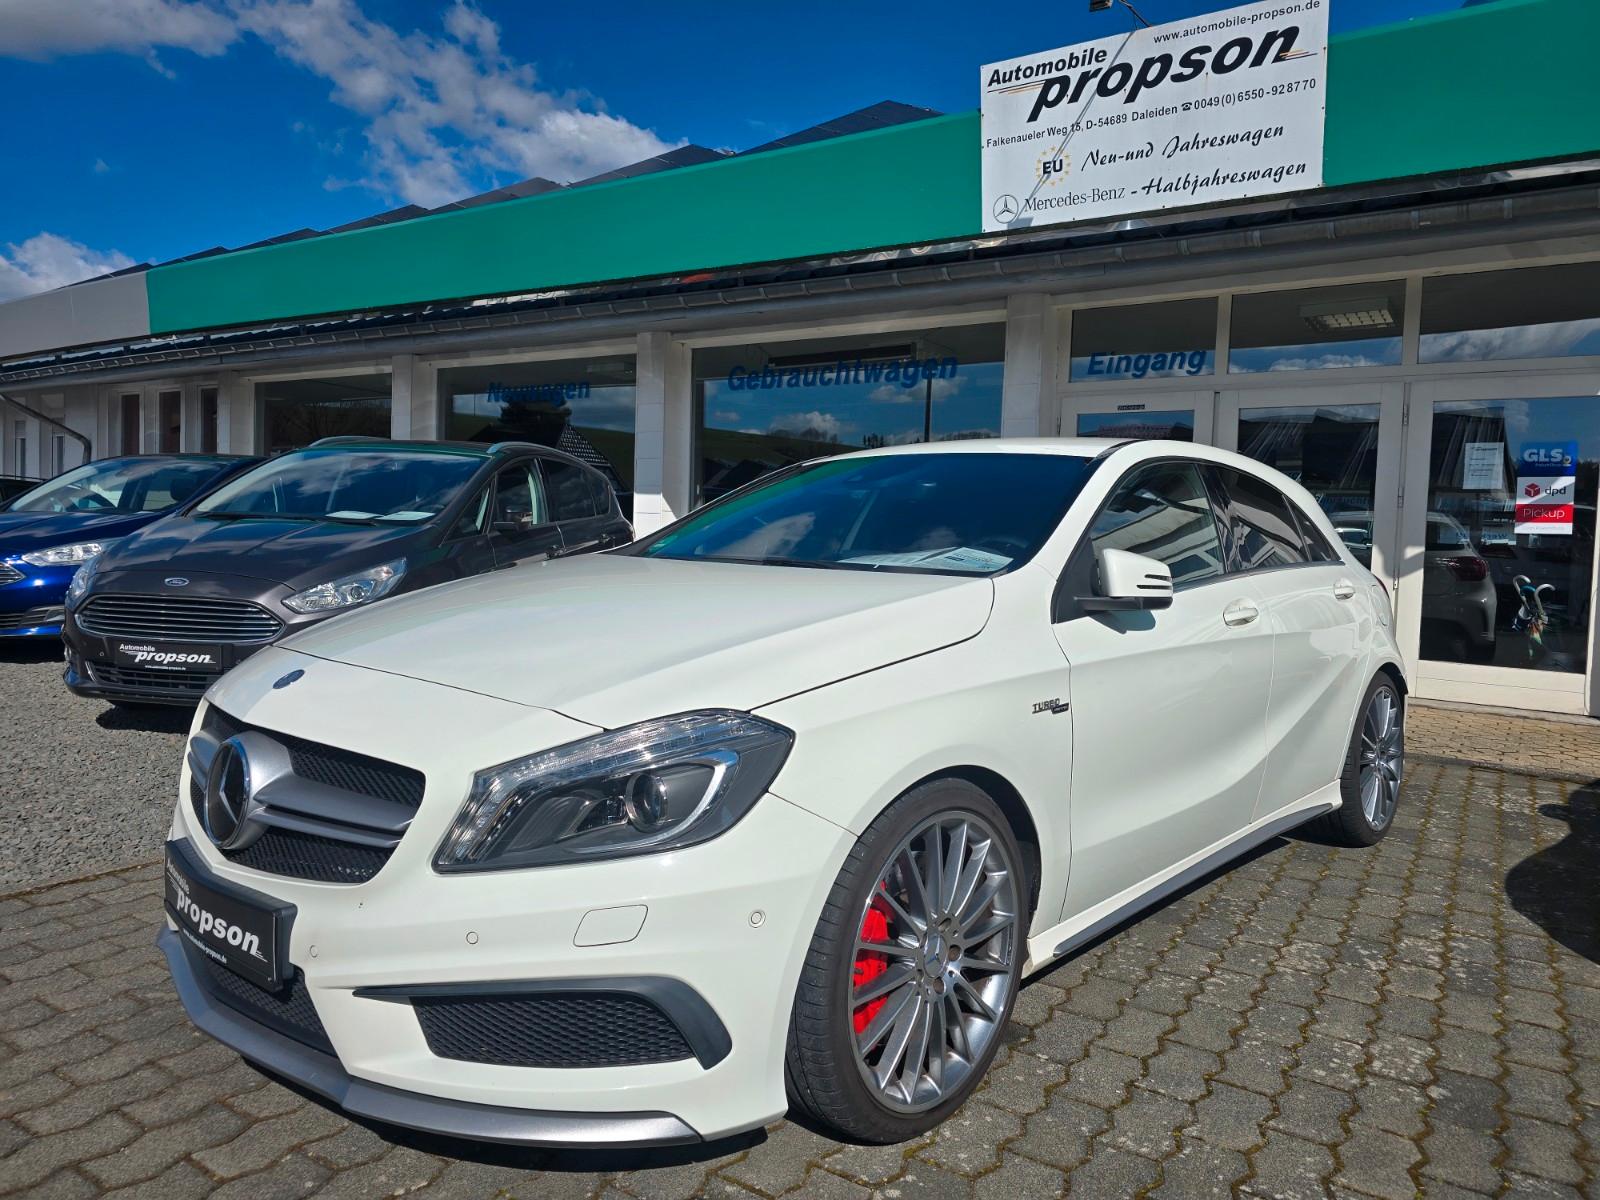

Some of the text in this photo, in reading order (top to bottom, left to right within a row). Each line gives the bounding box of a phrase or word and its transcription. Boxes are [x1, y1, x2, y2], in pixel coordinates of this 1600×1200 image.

[1154, 0, 1320, 43] www.automobile-propson.de
[988, 48, 1108, 87] Automobile
[1026, 26, 1300, 123] propson
[986, 130, 1045, 148] Falkenaueler
[1047, 125, 1068, 137] Weg
[1086, 113, 1127, 130] D-54689
[1131, 105, 1178, 122] Daleiden
[1162, 126, 1284, 158] Jahreswagen
[1043, 159, 1064, 175] EU
[1024, 187, 1125, 212] Mercedes-Benz
[727, 356, 958, 391] Gebrauchtwagen
[1088, 350, 1206, 378] Eingang
[487, 382, 590, 408] Neuwagen
[1523, 448, 1564, 463] GLS
[1544, 486, 1567, 496] dpd
[1523, 508, 1565, 519] Pickup
[119, 643, 156, 652] Automobile
[134, 652, 212, 664] propson
[1031, 698, 1060, 714] TURBO
[176, 889, 260, 956] propson
